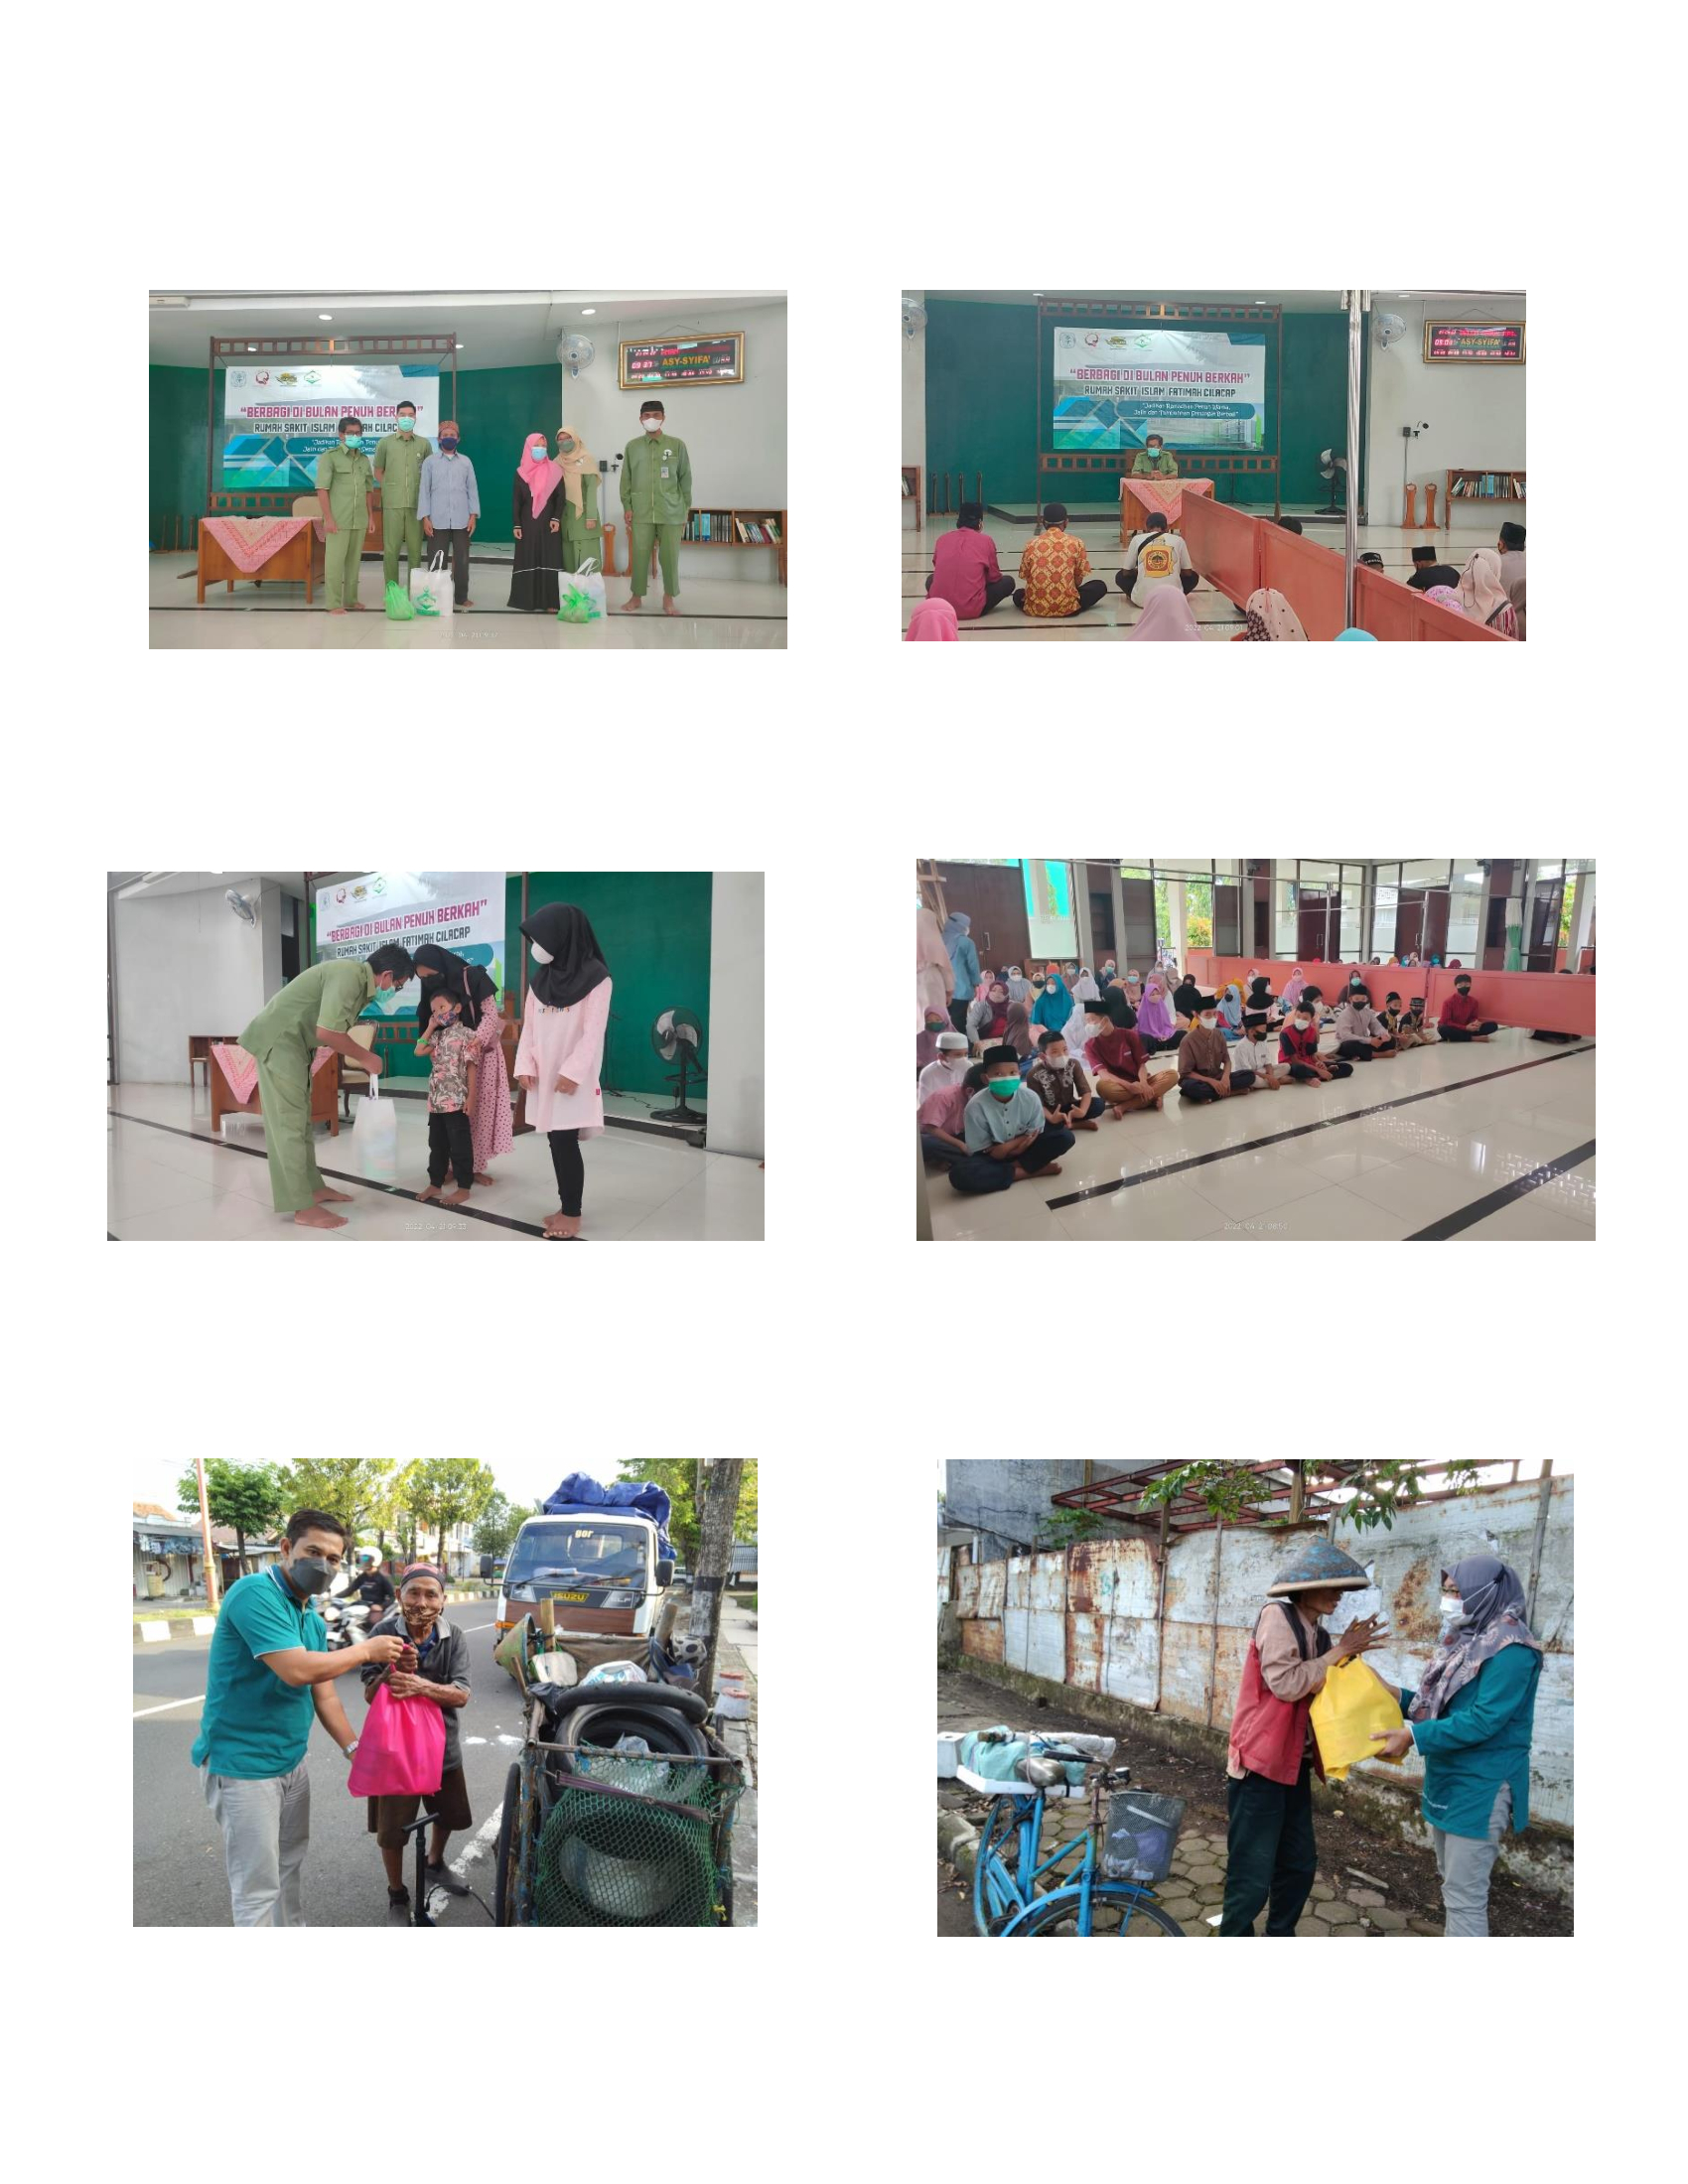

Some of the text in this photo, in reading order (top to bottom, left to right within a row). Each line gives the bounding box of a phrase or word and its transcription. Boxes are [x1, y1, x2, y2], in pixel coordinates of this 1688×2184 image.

[1123, 369, 1134, 381] DI
[1135, 369, 1169, 382] BULAN
[1171, 370, 1203, 383] PENUH
[1084, 385, 1236, 397] RUMAH SAKIT ISLAM FATIMAH CILACAP
[292, 406, 303, 418] DI
[305, 405, 339, 418] BULAN
[341, 405, 374, 417] PENUH
[254, 423, 283, 433] RUMAH
[284, 423, 308, 433] SAKIT
[311, 423, 336, 433] ISLAM
[363, 923, 373, 936] DI
[374, 917, 402, 934] BULAN
[403, 910, 435, 929] PENUH
[337, 945, 357, 957] RUMAH
[358, 941, 376, 954] SAKIT
[402, 931, 435, 947] FATIMAH
[436, 926, 471, 943] CILACAP
[575, 1530, 594, 1539] gor
[554, 1592, 585, 1601] ISUZU
